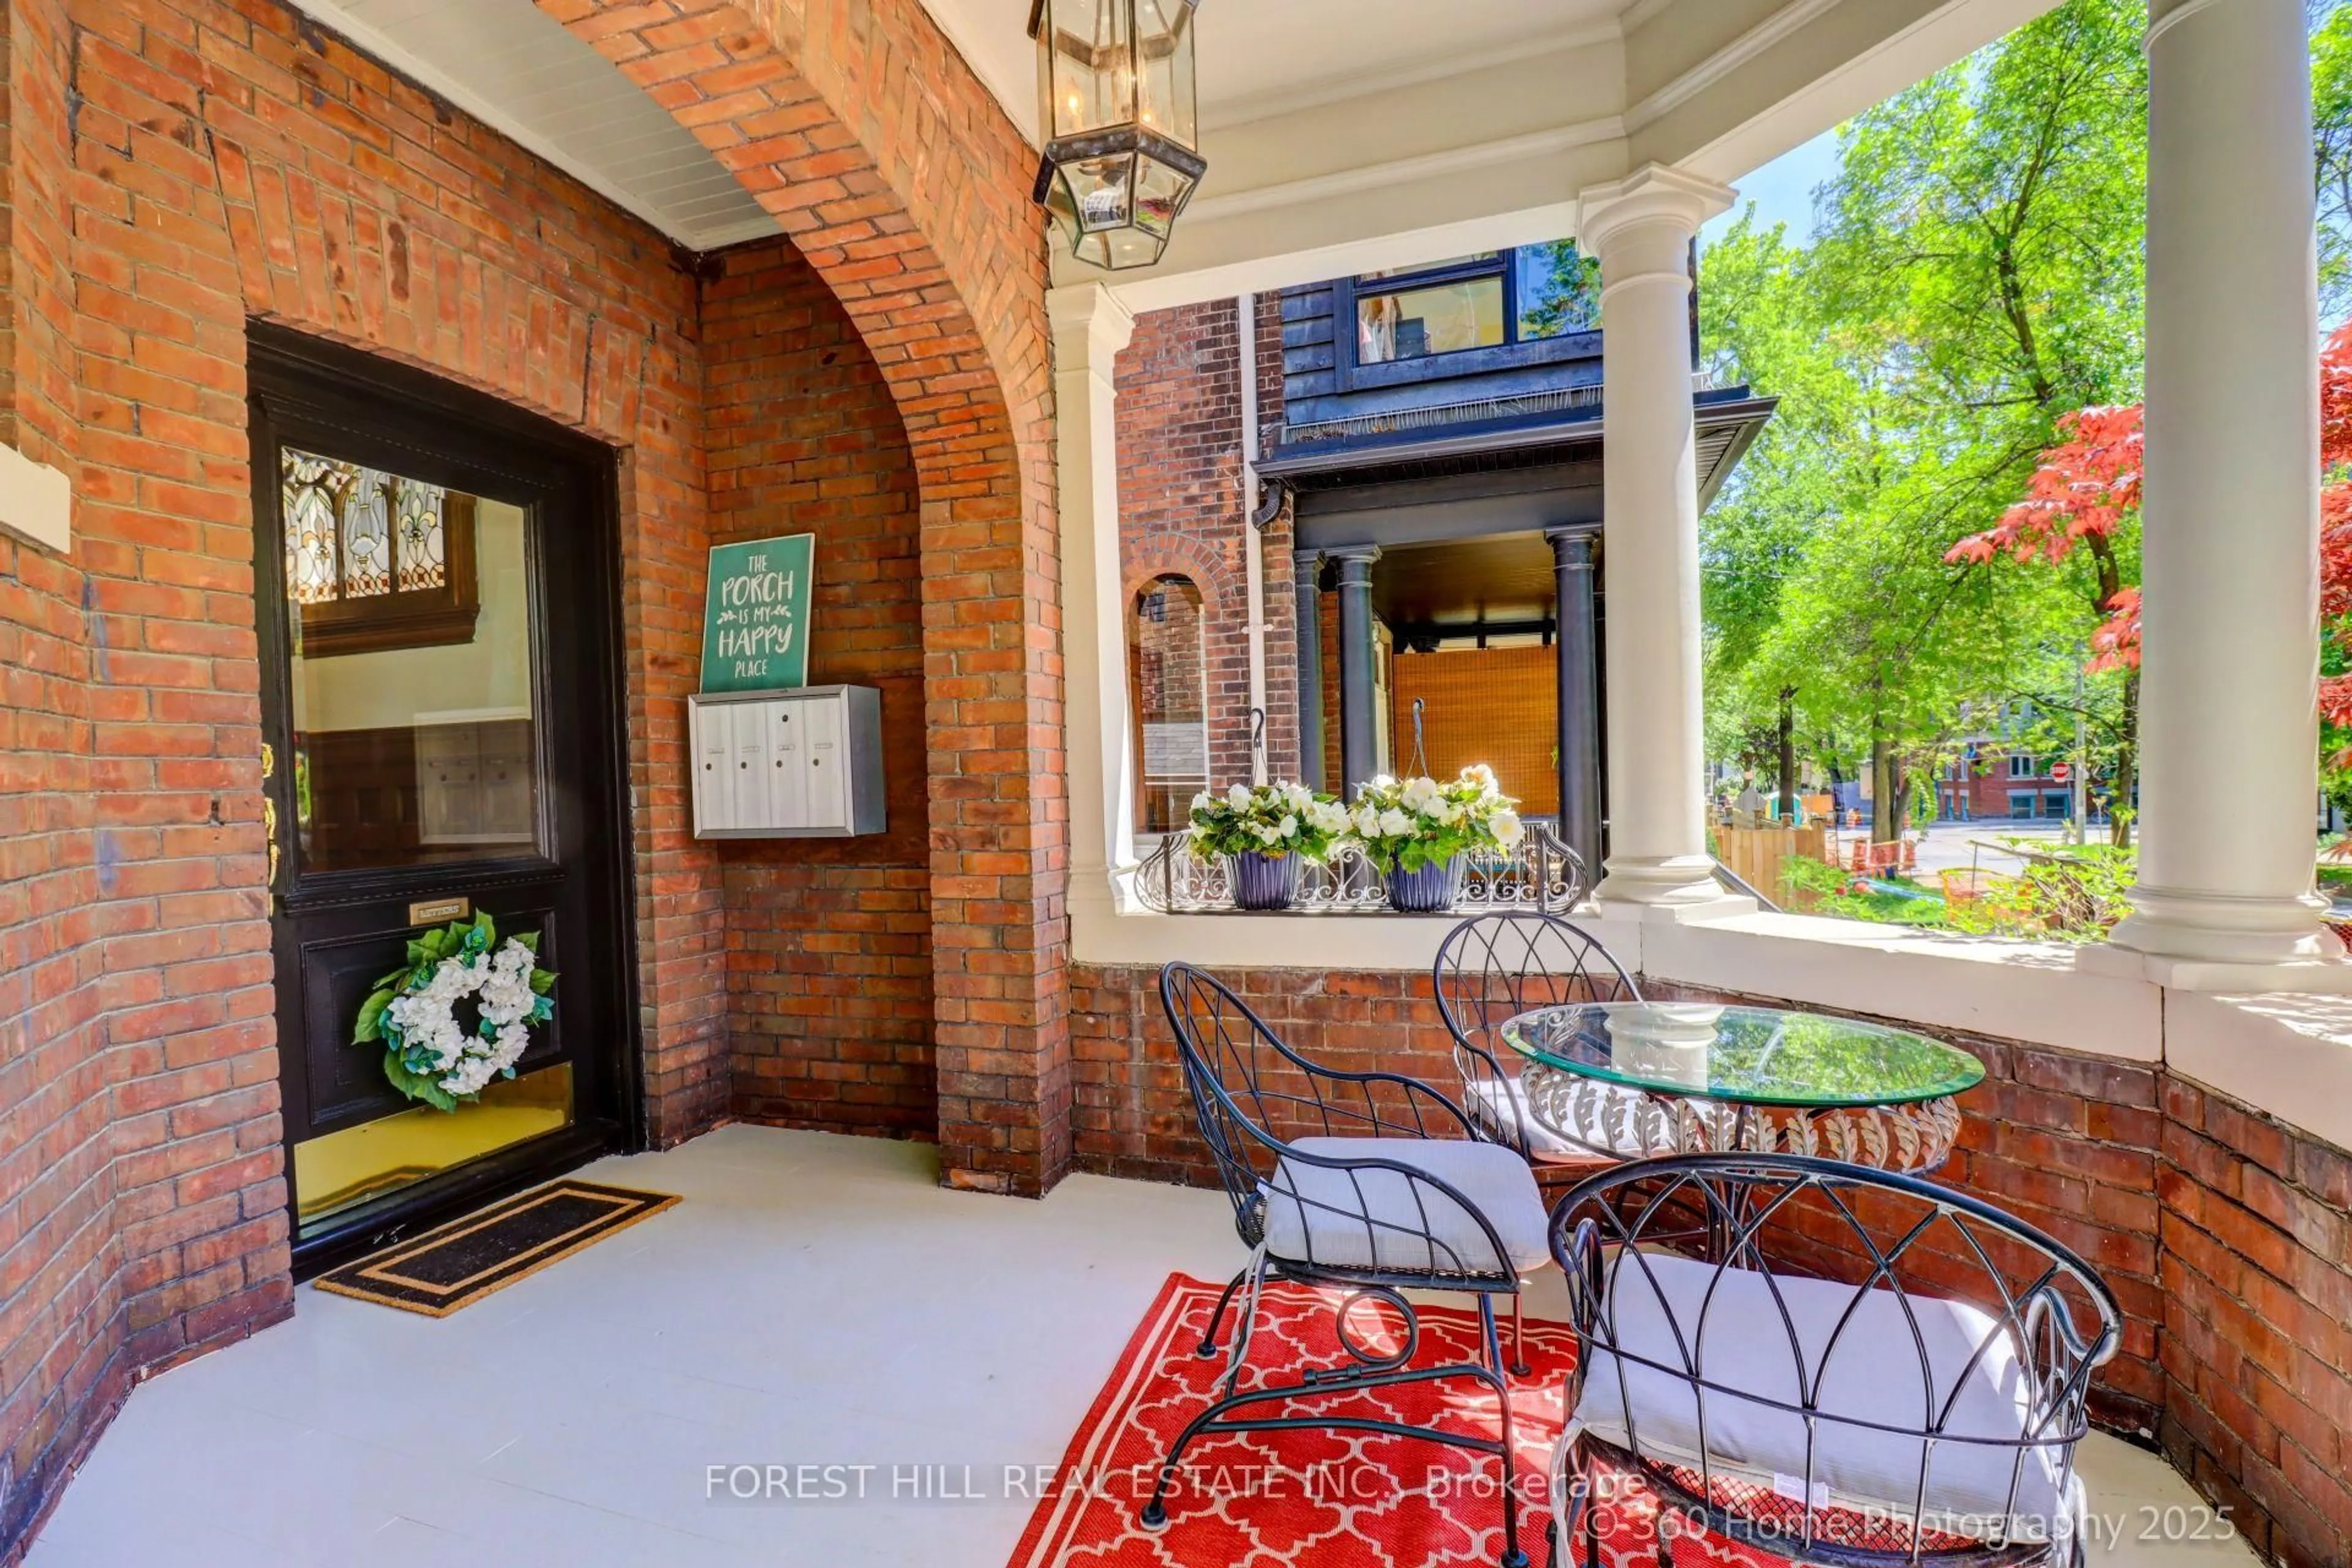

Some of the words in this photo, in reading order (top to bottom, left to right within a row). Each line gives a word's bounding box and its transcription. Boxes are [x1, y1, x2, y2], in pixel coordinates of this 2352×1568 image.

[748, 554, 769, 573] THE
[722, 570, 794, 606] PORCH
[739, 608, 749, 625] IS
[753, 606, 771, 622] MY
[718, 622, 793, 658] HAPPY
[735, 659, 769, 679] PLACE
